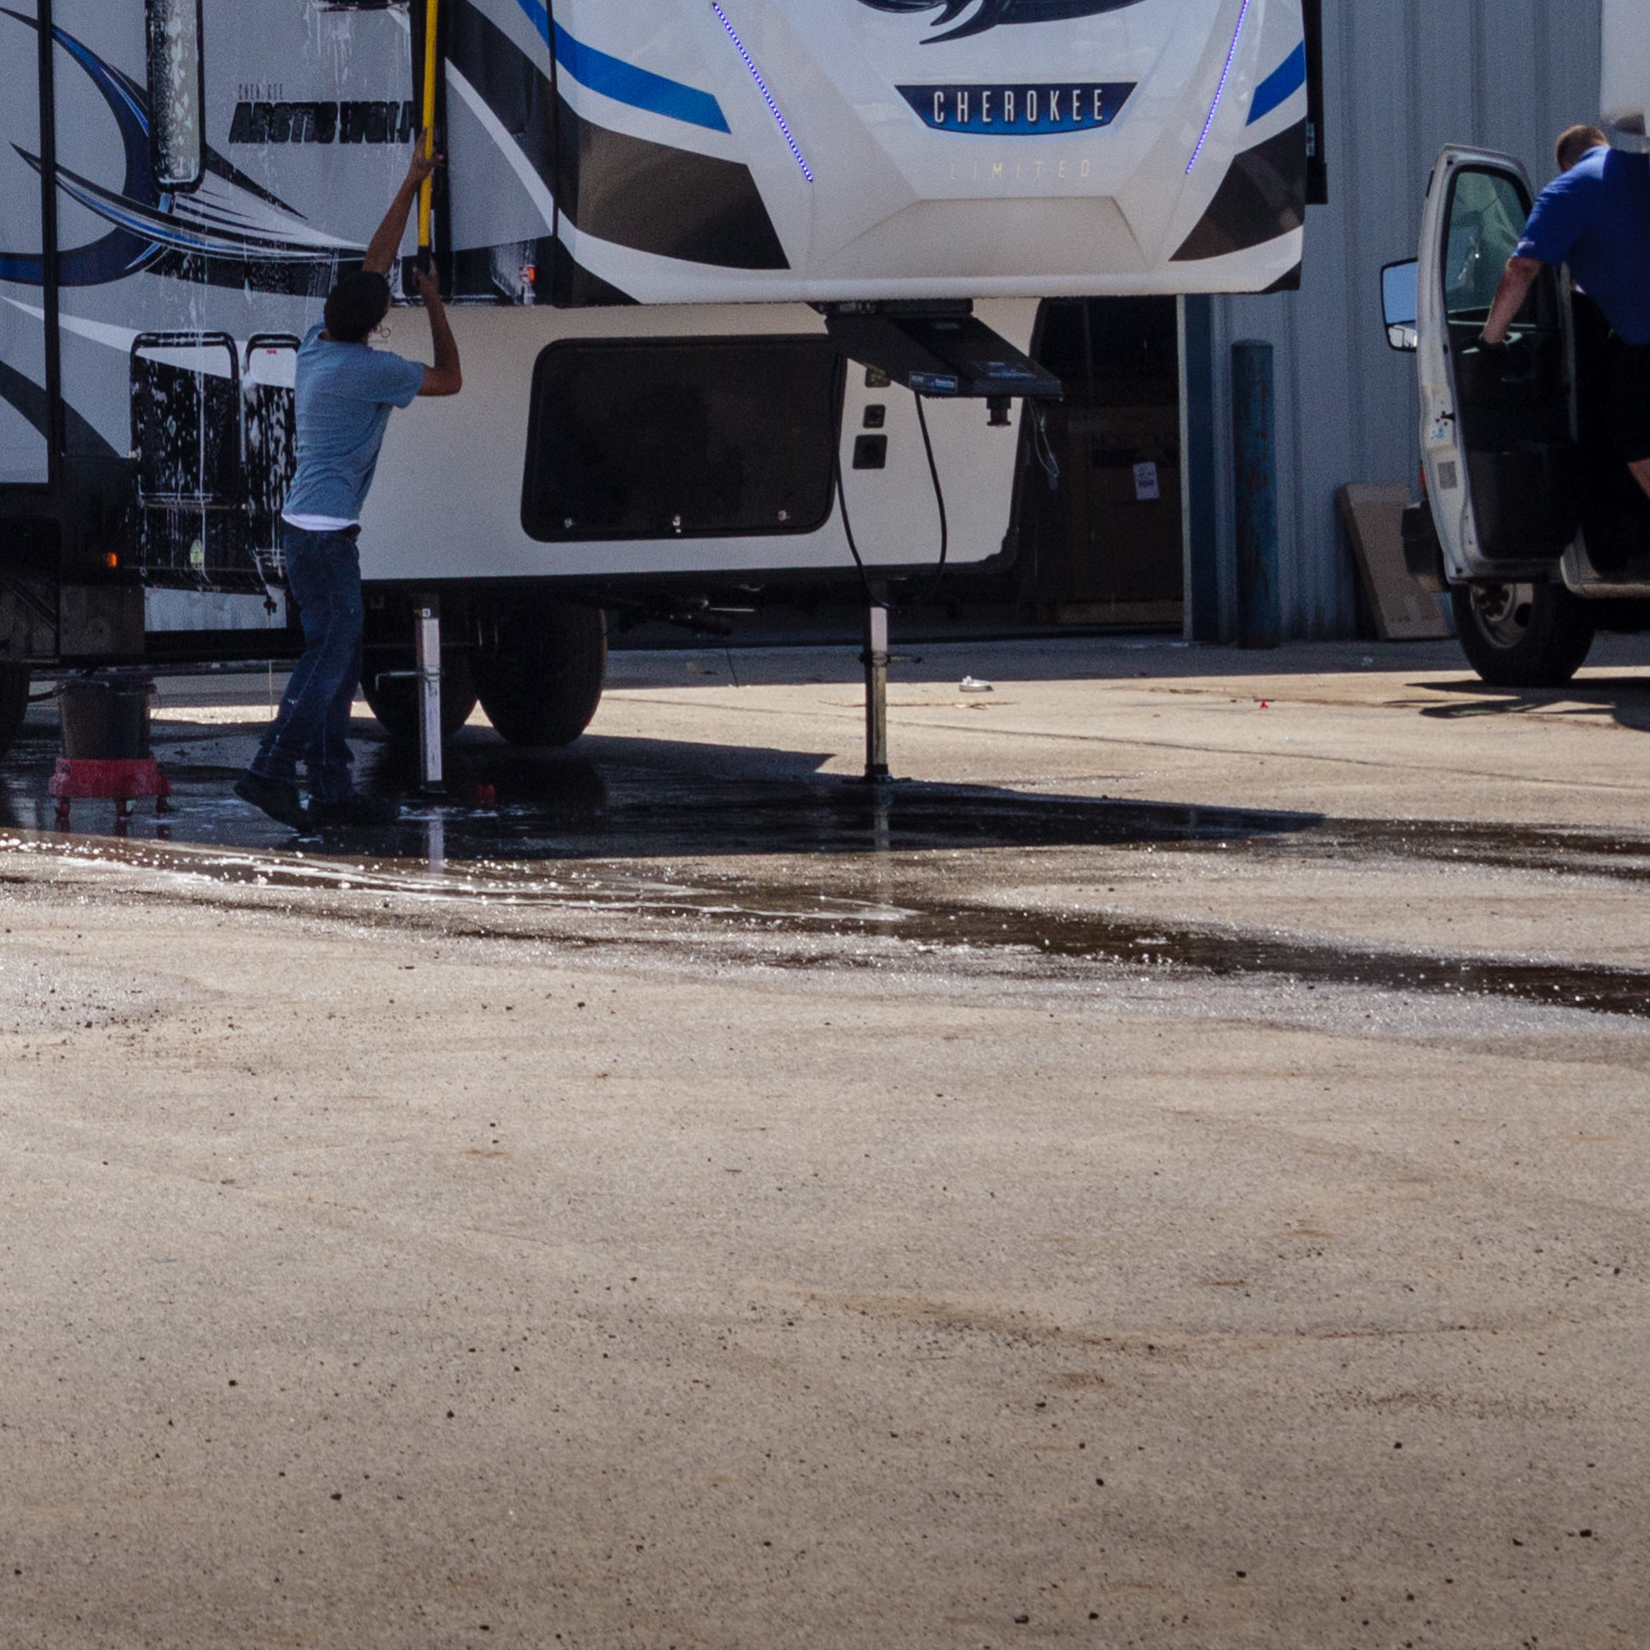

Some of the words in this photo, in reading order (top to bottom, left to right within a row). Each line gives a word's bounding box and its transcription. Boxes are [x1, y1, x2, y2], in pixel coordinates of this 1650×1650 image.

[238, 83, 284, 100] CHERKEE
[933, 89, 1104, 124] CHEROKEE
[949, 159, 1090, 181] LIMITED
